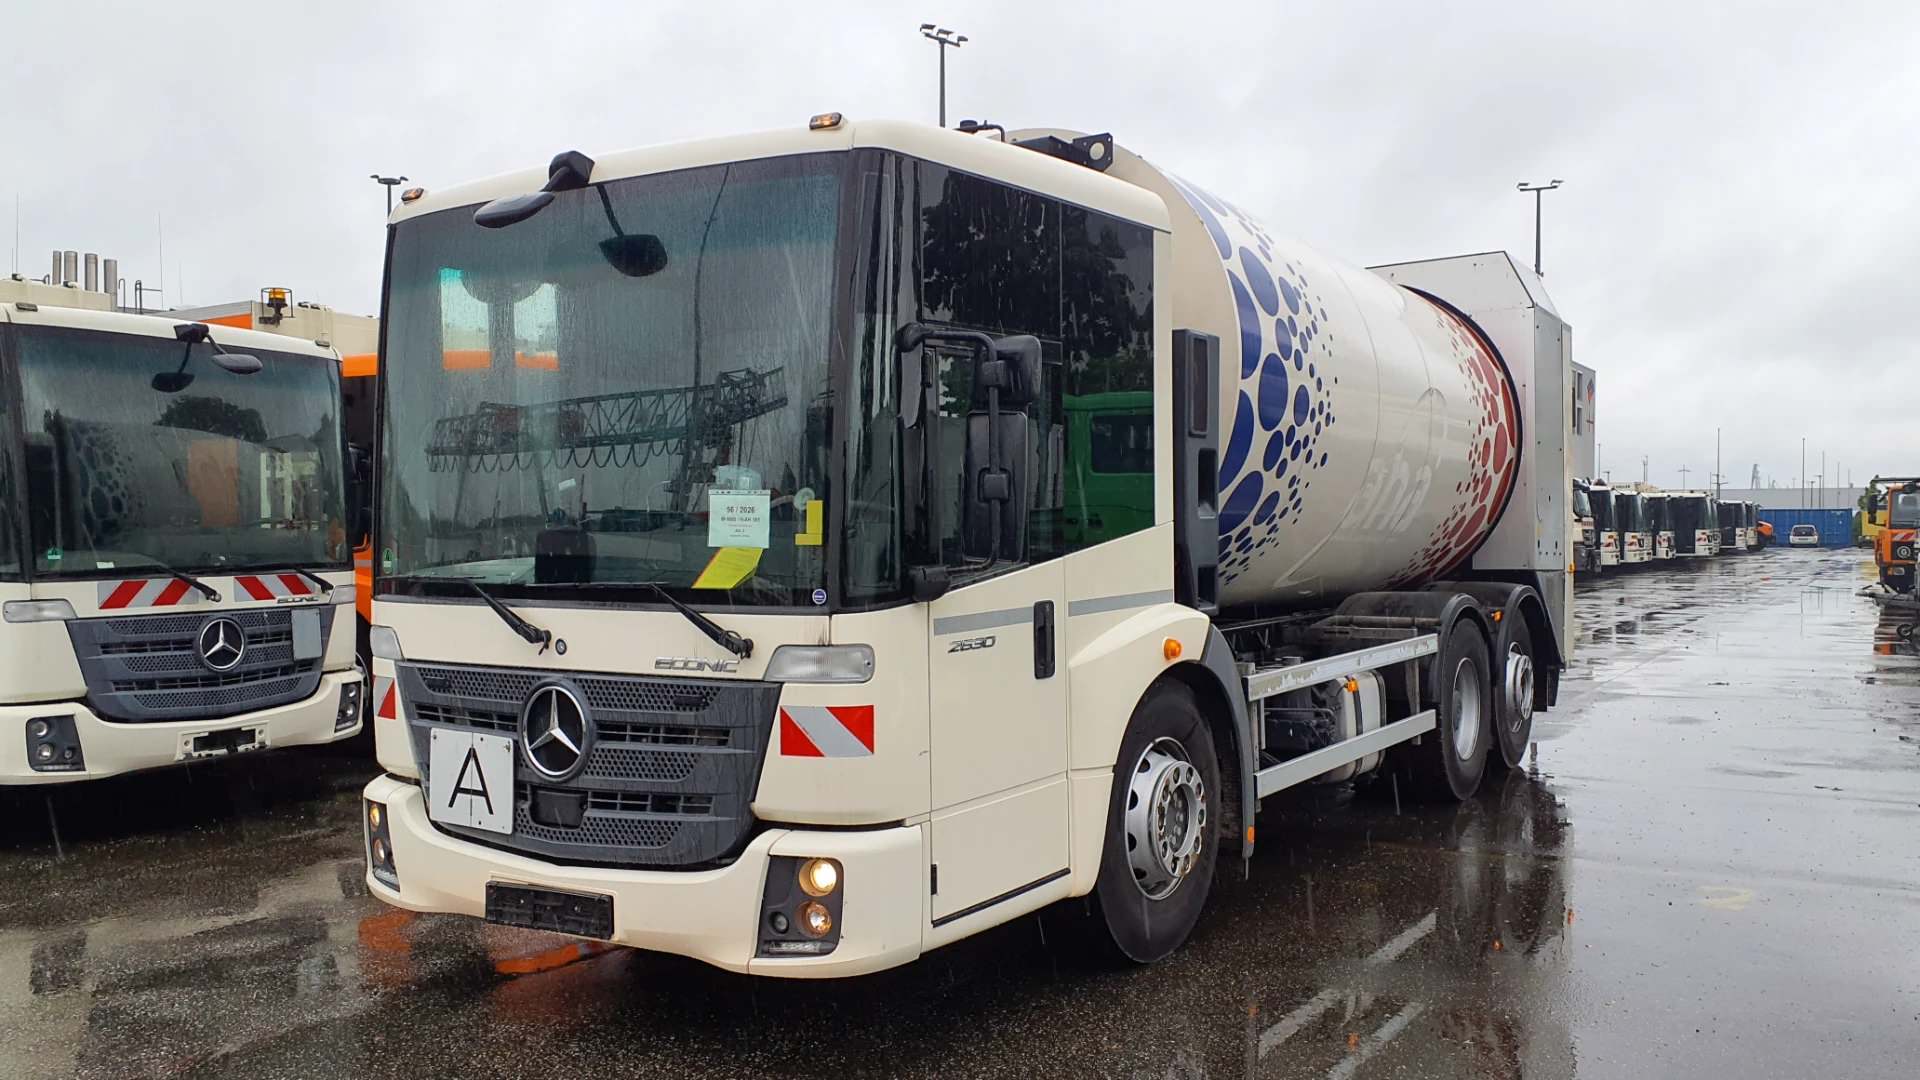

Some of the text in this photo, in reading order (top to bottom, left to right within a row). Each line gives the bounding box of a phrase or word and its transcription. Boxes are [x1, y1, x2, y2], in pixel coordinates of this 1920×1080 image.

[948, 636, 996, 653] 2630
[655, 656, 740, 673] ECONIC
[448, 746, 494, 815] A
